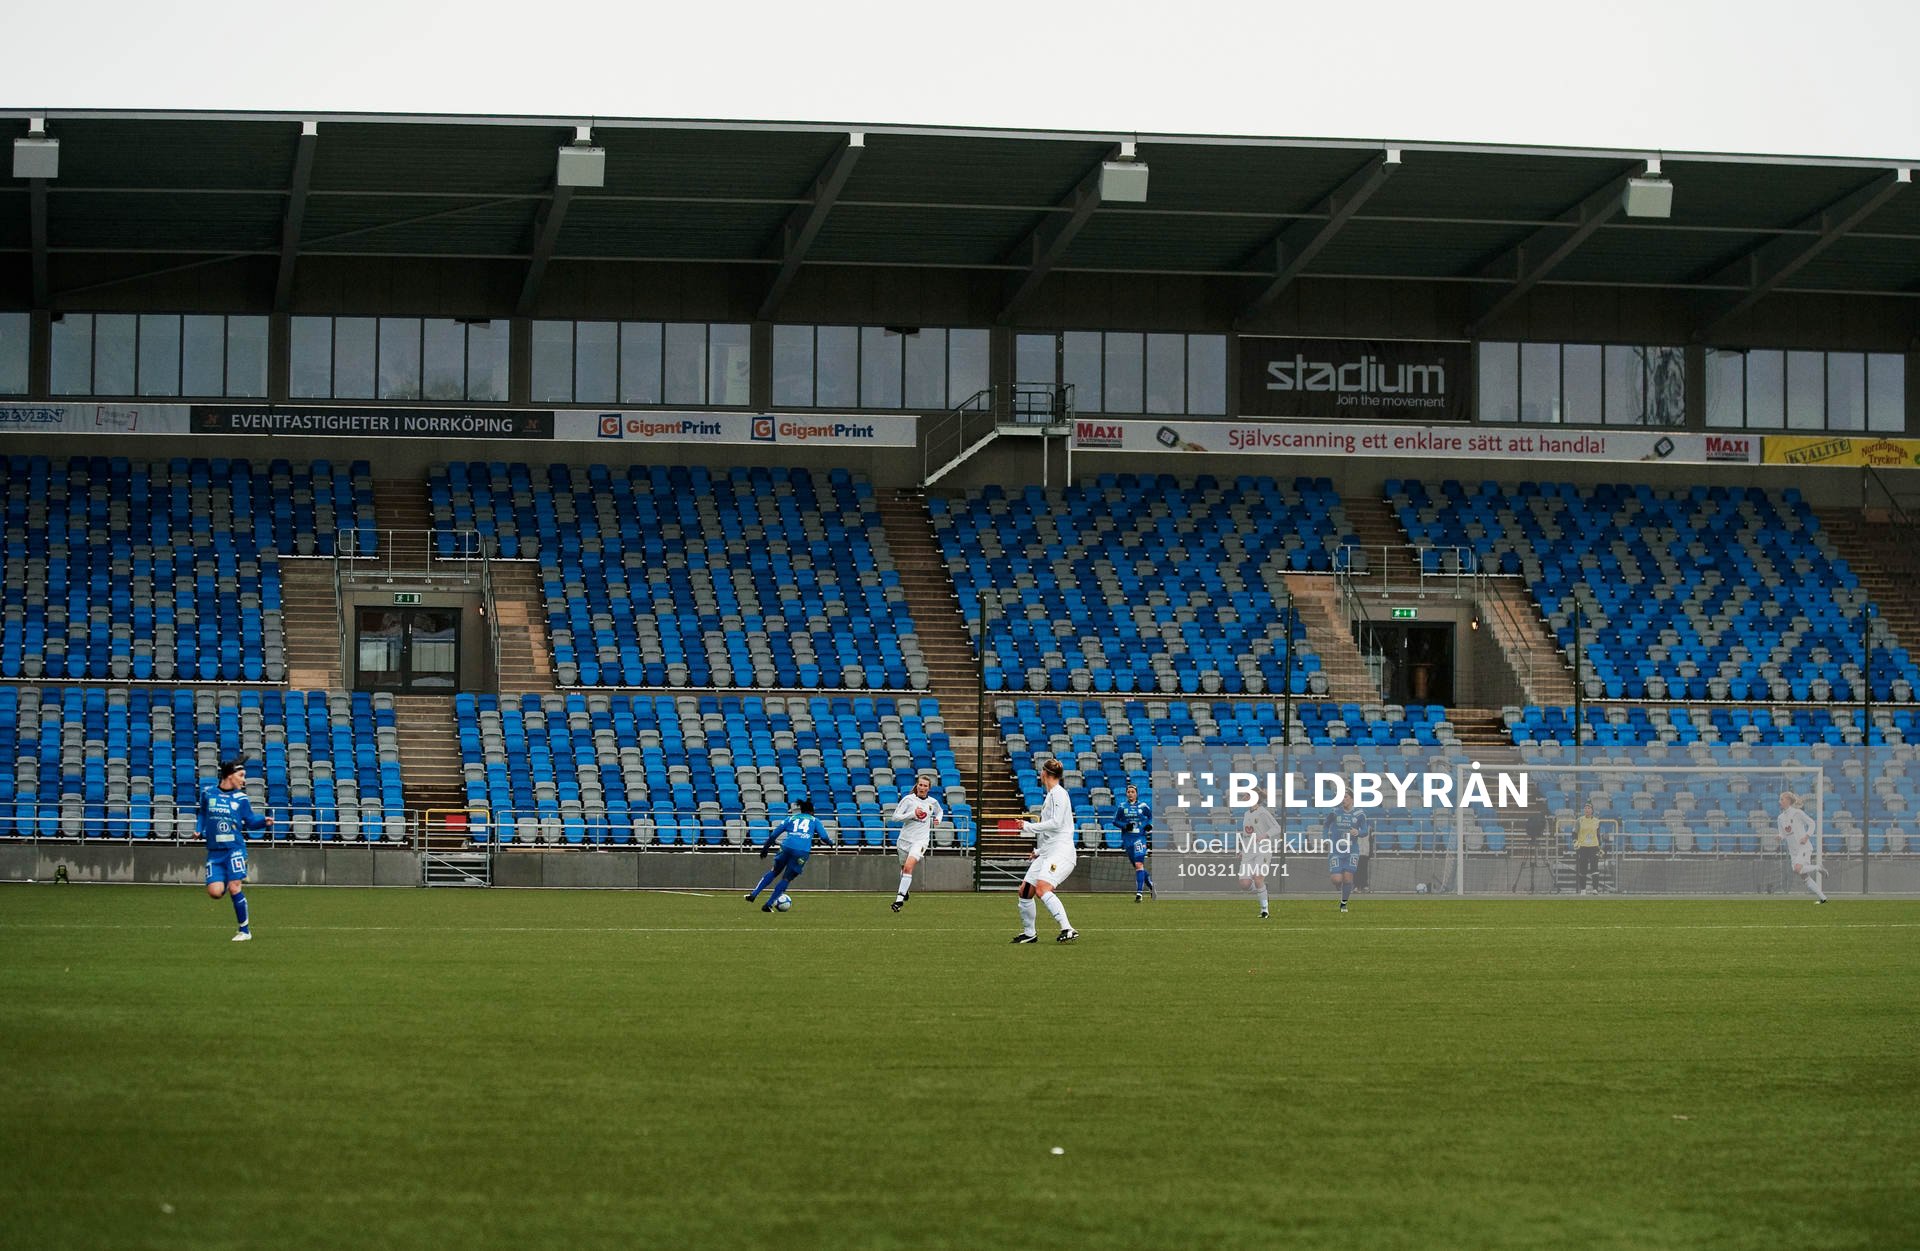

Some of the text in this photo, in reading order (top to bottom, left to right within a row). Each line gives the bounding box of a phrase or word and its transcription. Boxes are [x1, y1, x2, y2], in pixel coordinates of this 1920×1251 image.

[1266, 354, 1445, 393] stadium
[1336, 393, 1445, 408] Join the movement
[231, 414, 513, 433] EVENTFASTIGHETER I NORRKÖPING
[626, 420, 721, 436] GigantPrint
[779, 422, 874, 439] GigantPrint
[1228, 429, 1606, 454] Självscanning ett enklare sätt att handla!
[792, 818, 811, 833] 14
